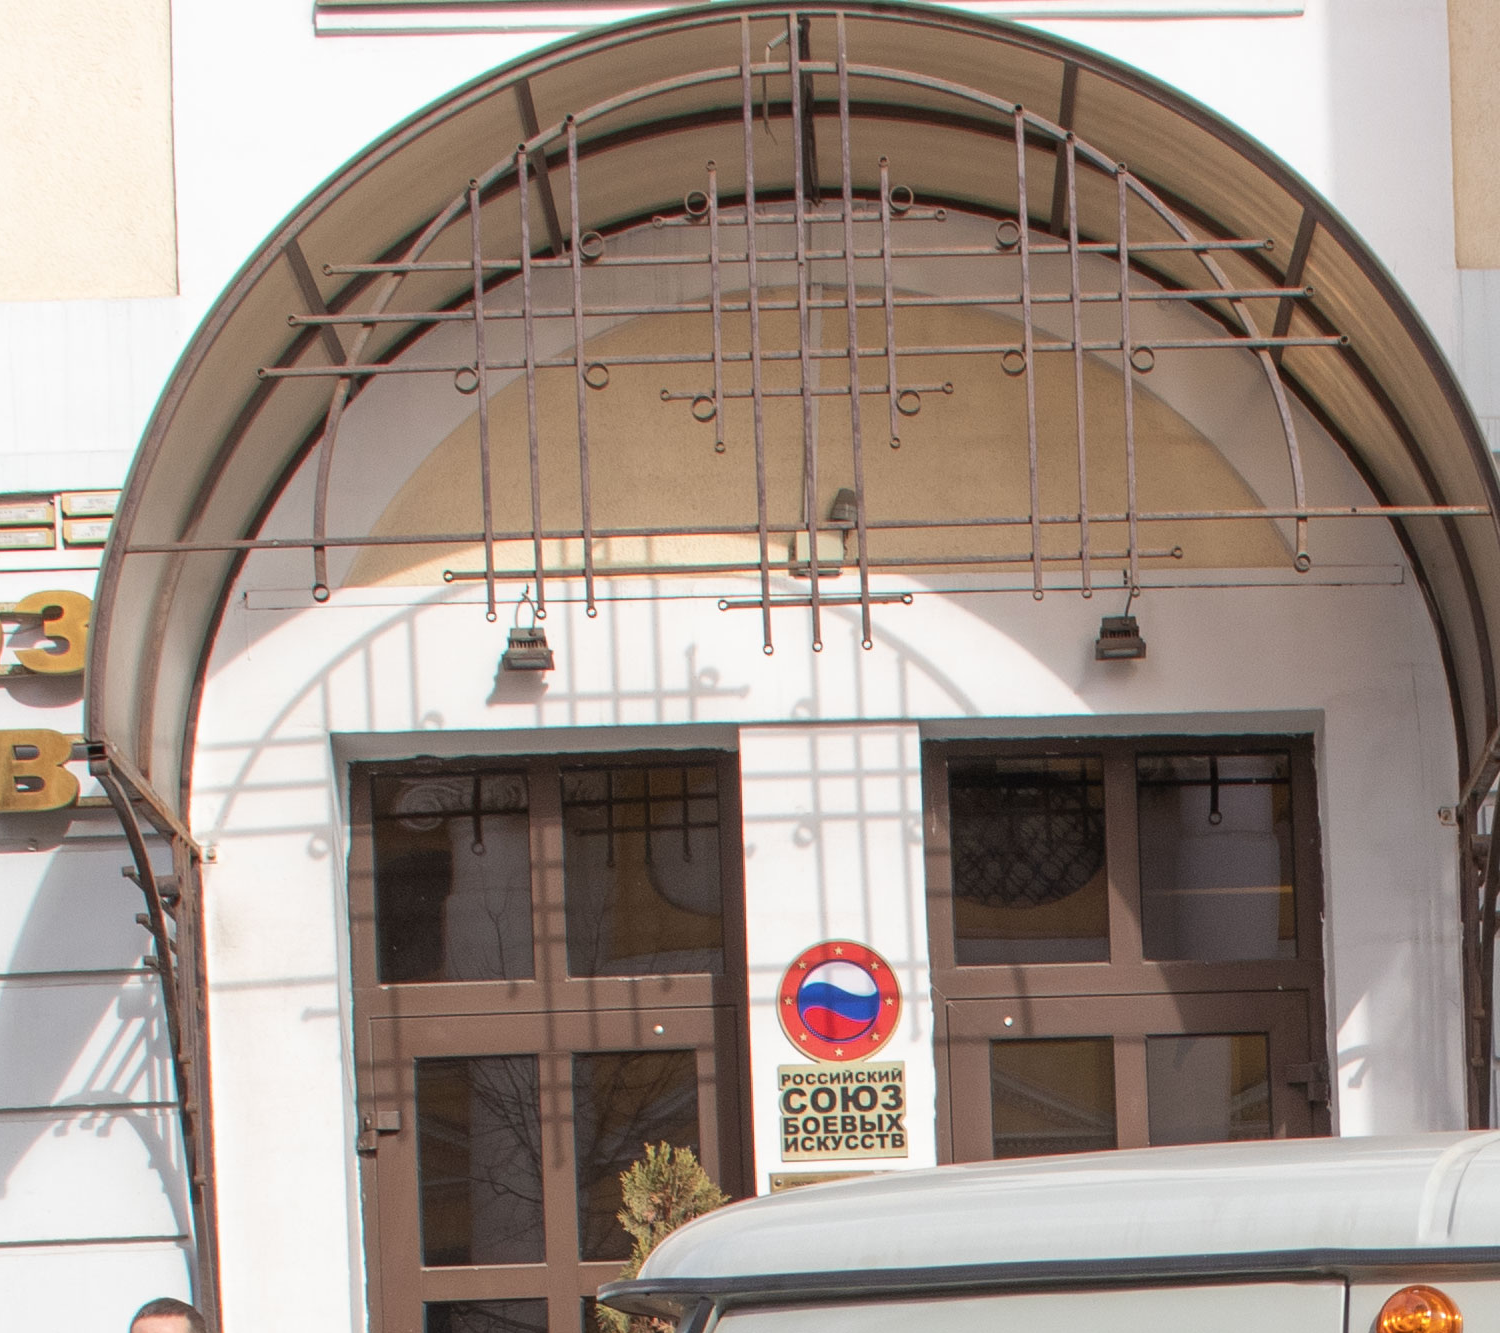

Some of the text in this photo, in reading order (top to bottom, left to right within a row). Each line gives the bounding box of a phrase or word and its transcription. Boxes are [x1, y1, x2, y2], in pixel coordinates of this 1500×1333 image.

[781, 1067, 903, 1087] РОССИЙСКИЙ
[781, 1084, 904, 1115] СОЮЗ
[783, 1113, 905, 1136] БОЕВЫХ
[784, 1132, 906, 1153] ИСКУССТВ
